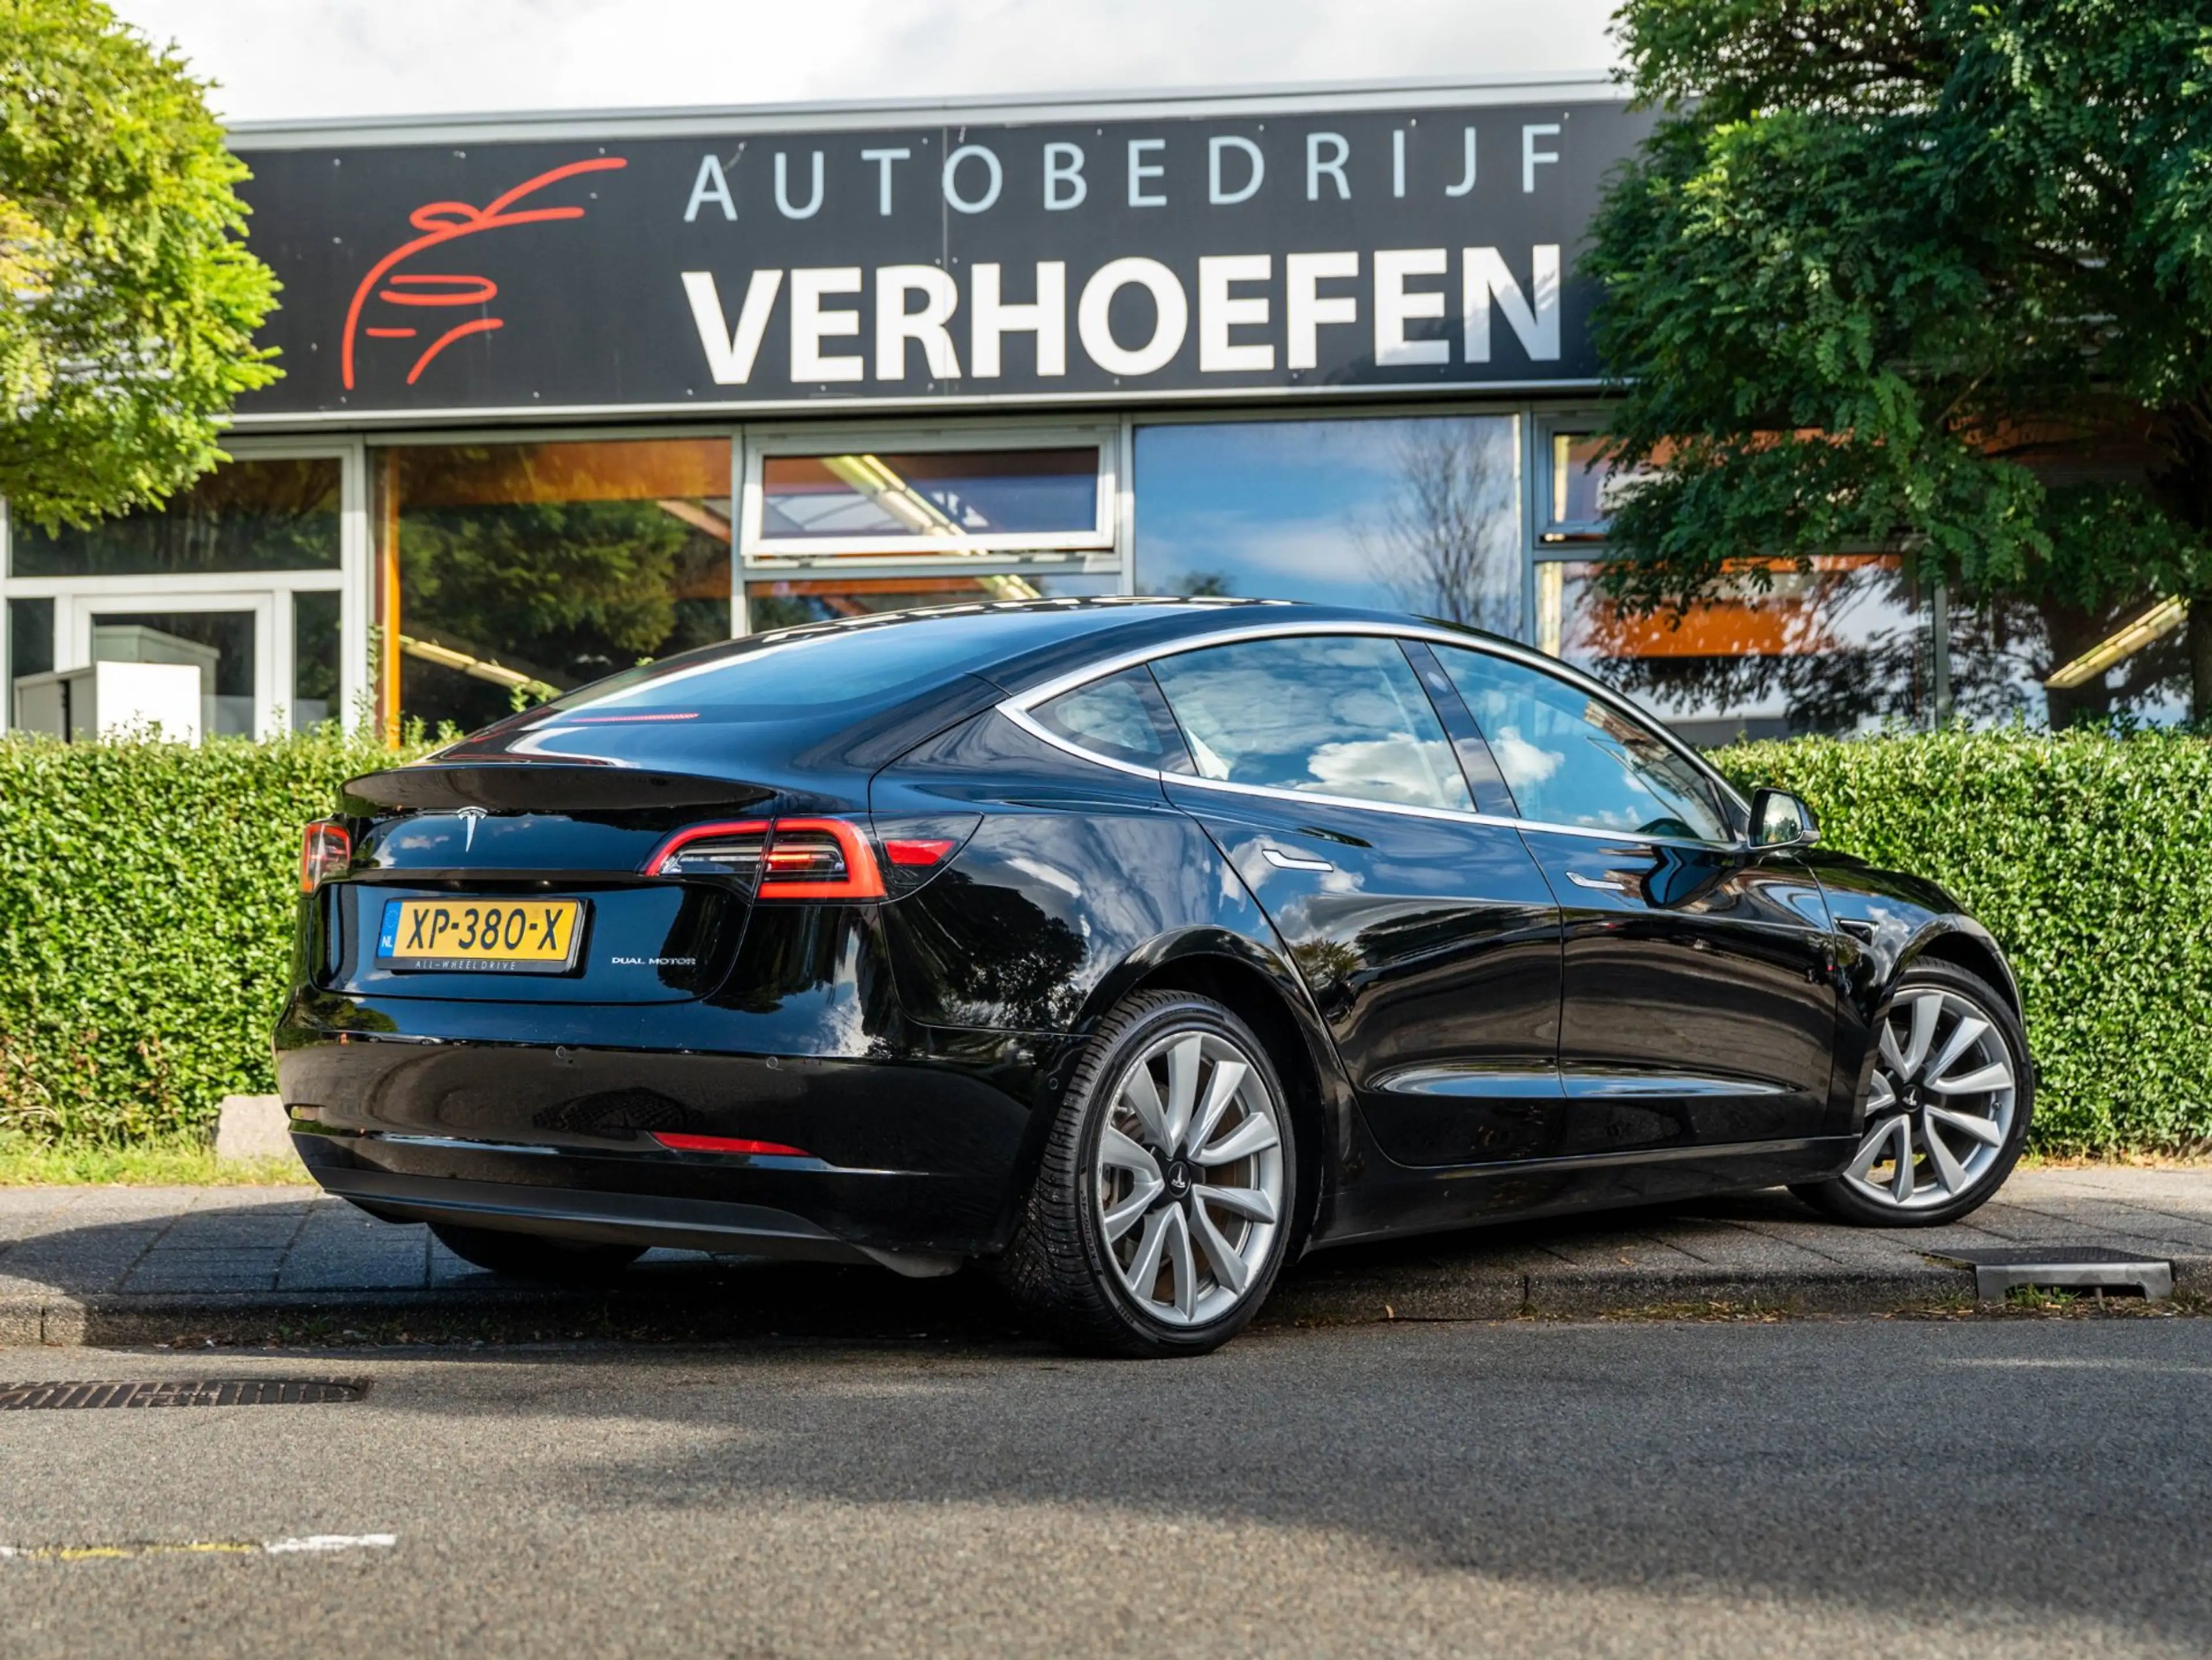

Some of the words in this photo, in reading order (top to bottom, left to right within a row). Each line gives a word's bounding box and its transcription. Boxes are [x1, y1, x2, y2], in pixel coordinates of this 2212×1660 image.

[684, 123, 1561, 222] AUTOBEDRIJF
[681, 244, 1560, 384] VERHOEFEN
[382, 935, 393, 948] NL
[406, 908, 564, 950] XP-380-X
[648, 957, 696, 965] MOTOR
